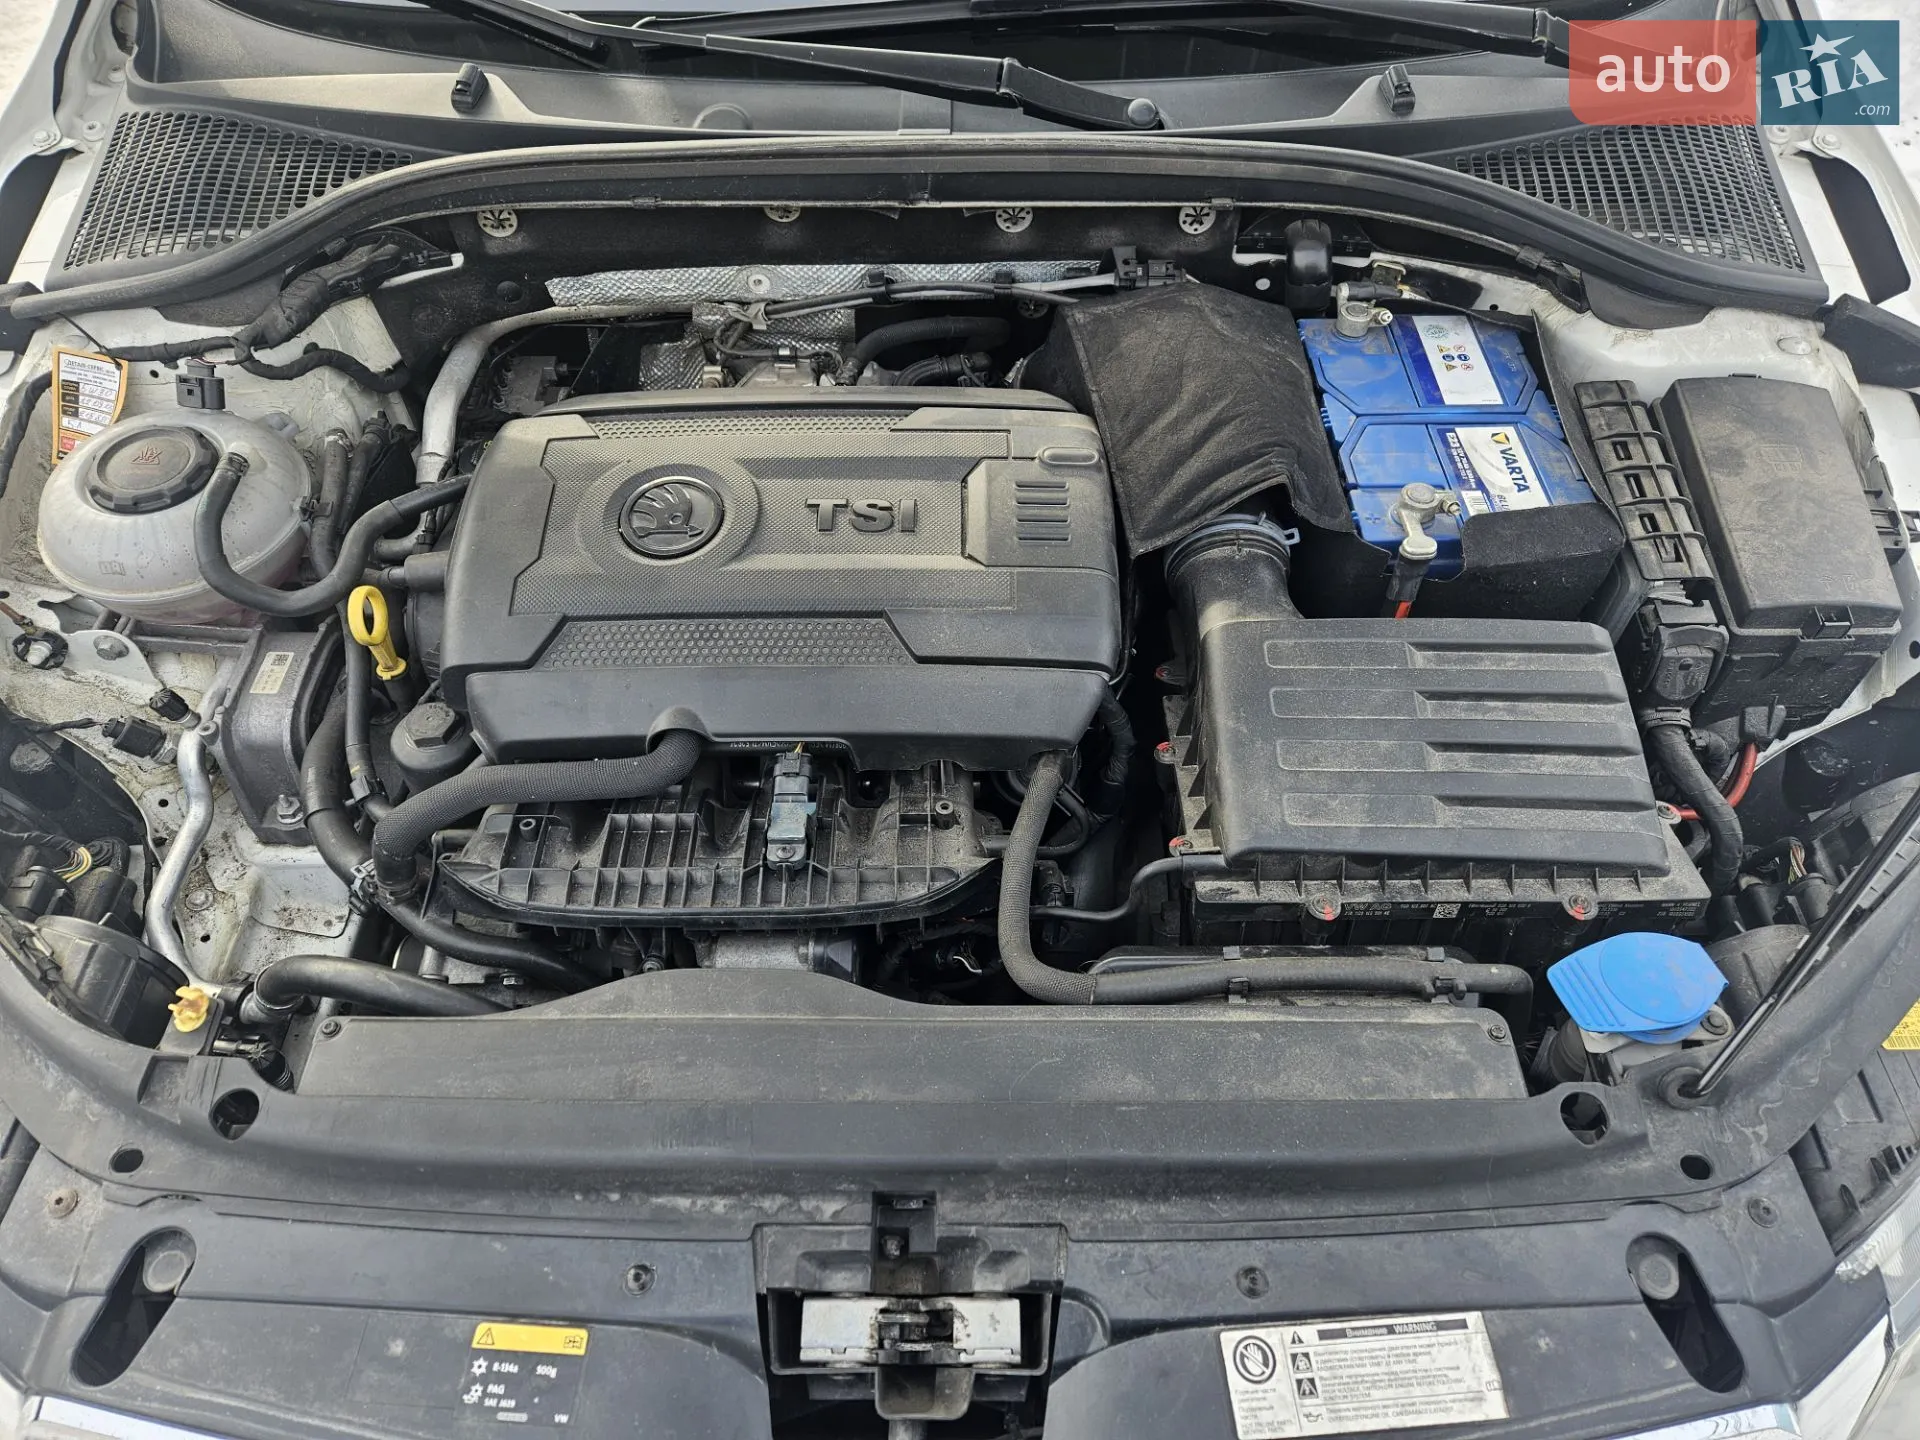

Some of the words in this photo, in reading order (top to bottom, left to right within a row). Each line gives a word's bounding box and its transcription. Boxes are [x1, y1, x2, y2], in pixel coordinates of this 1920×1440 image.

[1500, 446, 1530, 493] VARTA
[805, 499, 917, 532] TSI
[1346, 1326, 1389, 1338] Внимание
[1393, 1321, 1438, 1334] WARNING
[486, 1383, 506, 1395] PAG
[554, 1413, 569, 1424] VW
